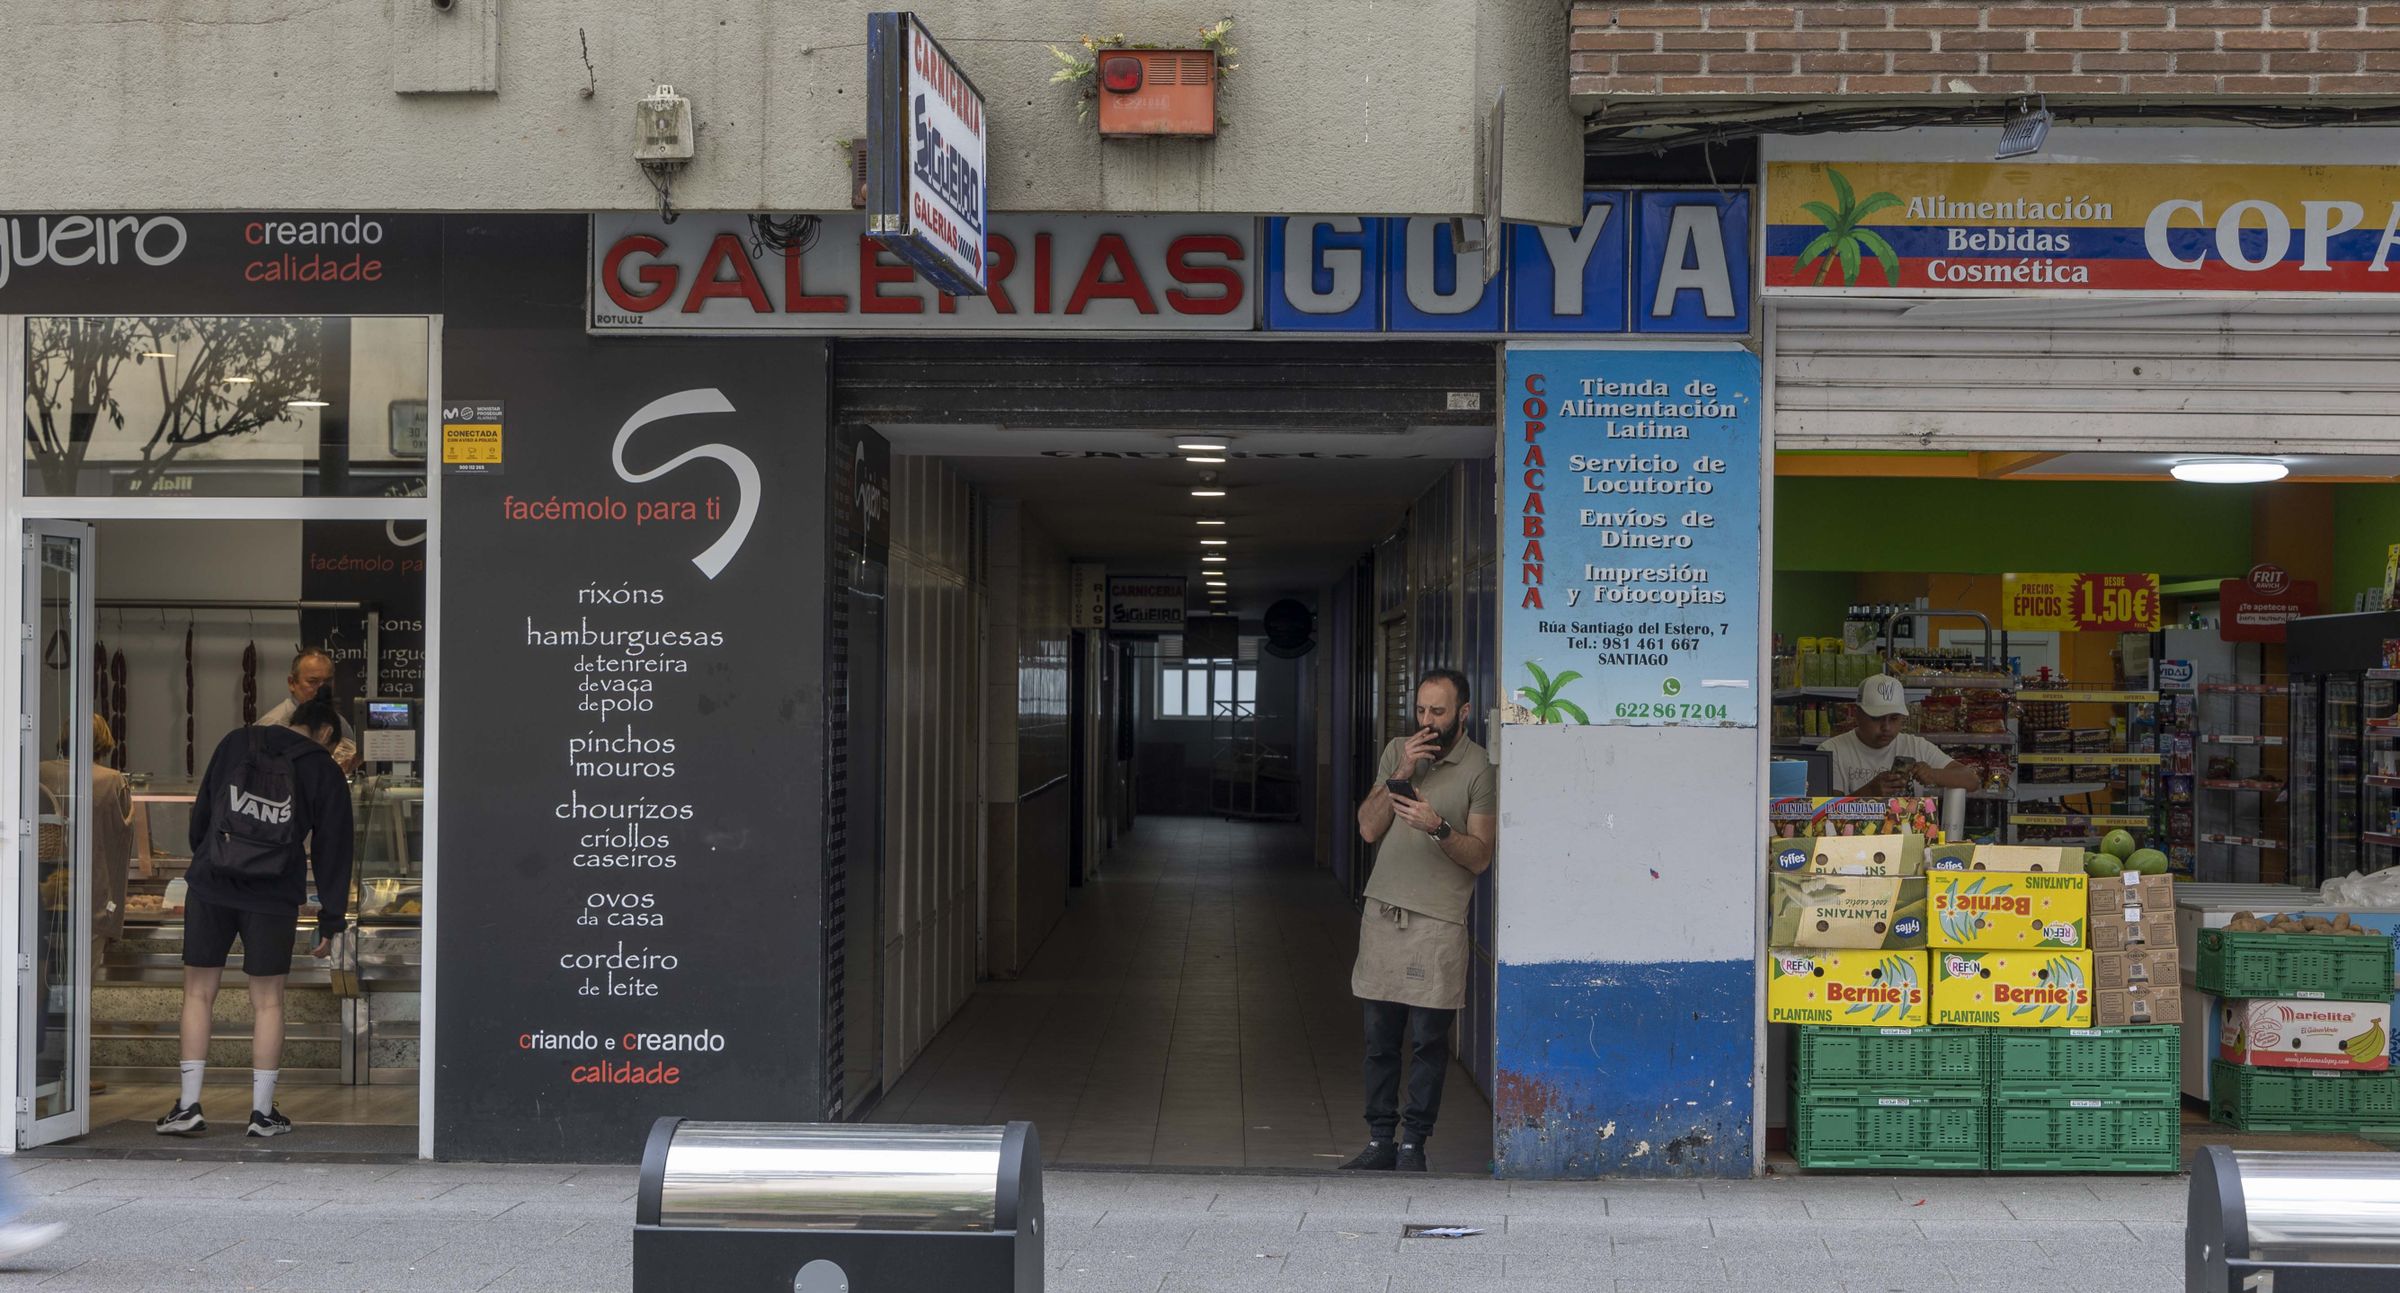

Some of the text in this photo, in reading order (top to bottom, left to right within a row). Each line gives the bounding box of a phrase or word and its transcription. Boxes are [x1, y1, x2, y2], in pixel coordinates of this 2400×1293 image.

[914, 30, 980, 139] CARNICERIA
[1905, 194, 2113, 222] Alimentación
[244, 214, 383, 244] creando
[914, 191, 958, 252] GALERIAS
[1947, 228, 2071, 253] Bebidas
[244, 254, 383, 282] calidade
[1284, 204, 1736, 318] GOYA
[601, 233, 1245, 315] GALERIAS
[1926, 259, 2089, 284] Cosmética
[596, 314, 644, 324] ROTULUZ
[1580, 378, 1717, 396] Tienda de
[1559, 398, 1738, 419] Alimentación
[1606, 420, 1689, 438] Latina
[1569, 454, 1726, 473] Servicio de
[1521, 374, 1548, 610] COPACABANA
[1583, 475, 1713, 494] Locutorio
[504, 496, 722, 526] facémolo para ti
[1580, 507, 1714, 527] Envíos de
[1601, 530, 1692, 548] Dinero
[310, 552, 394, 572] facémolo
[1584, 562, 1708, 586] Impresión
[2104, 576, 2125, 586] DESDE
[2253, 571, 2284, 583] FRIT
[1112, 584, 1184, 597] CARNICERIA
[1567, 585, 1726, 608] y Fotocopias
[2022, 584, 2054, 595] PRECIOS
[2014, 596, 2062, 617] ÉPICOS
[526, 616, 724, 656] hamburguesas
[1538, 621, 1729, 636] Rúa Santiago del Estero, 7
[1566, 637, 1700, 650] Tel.: 981 461 667
[595, 653, 688, 673] tenreira
[1598, 652, 1669, 666] SANTIAGO
[601, 686, 654, 722] polo
[570, 724, 676, 766] pinchos
[575, 762, 676, 778] mouros
[228, 784, 294, 825] VANS
[555, 790, 694, 820] chourizos
[580, 823, 670, 849] criollos
[572, 848, 677, 868] caseiros
[1779, 854, 1806, 868] fyffes
[2026, 876, 2084, 890] PLANTAINS
[587, 893, 655, 908] ovos
[576, 908, 664, 927] da casa
[1816, 908, 1888, 919] PLANTAINS
[560, 940, 678, 970] cordeiro
[578, 971, 659, 997] de leite
[1774, 1008, 1832, 1022] PLANTAINS
[1940, 1010, 2000, 1024] PLANTAINS
[519, 1030, 598, 1050] criando
[604, 1038, 616, 1050] e
[570, 1060, 681, 1085] calidade
